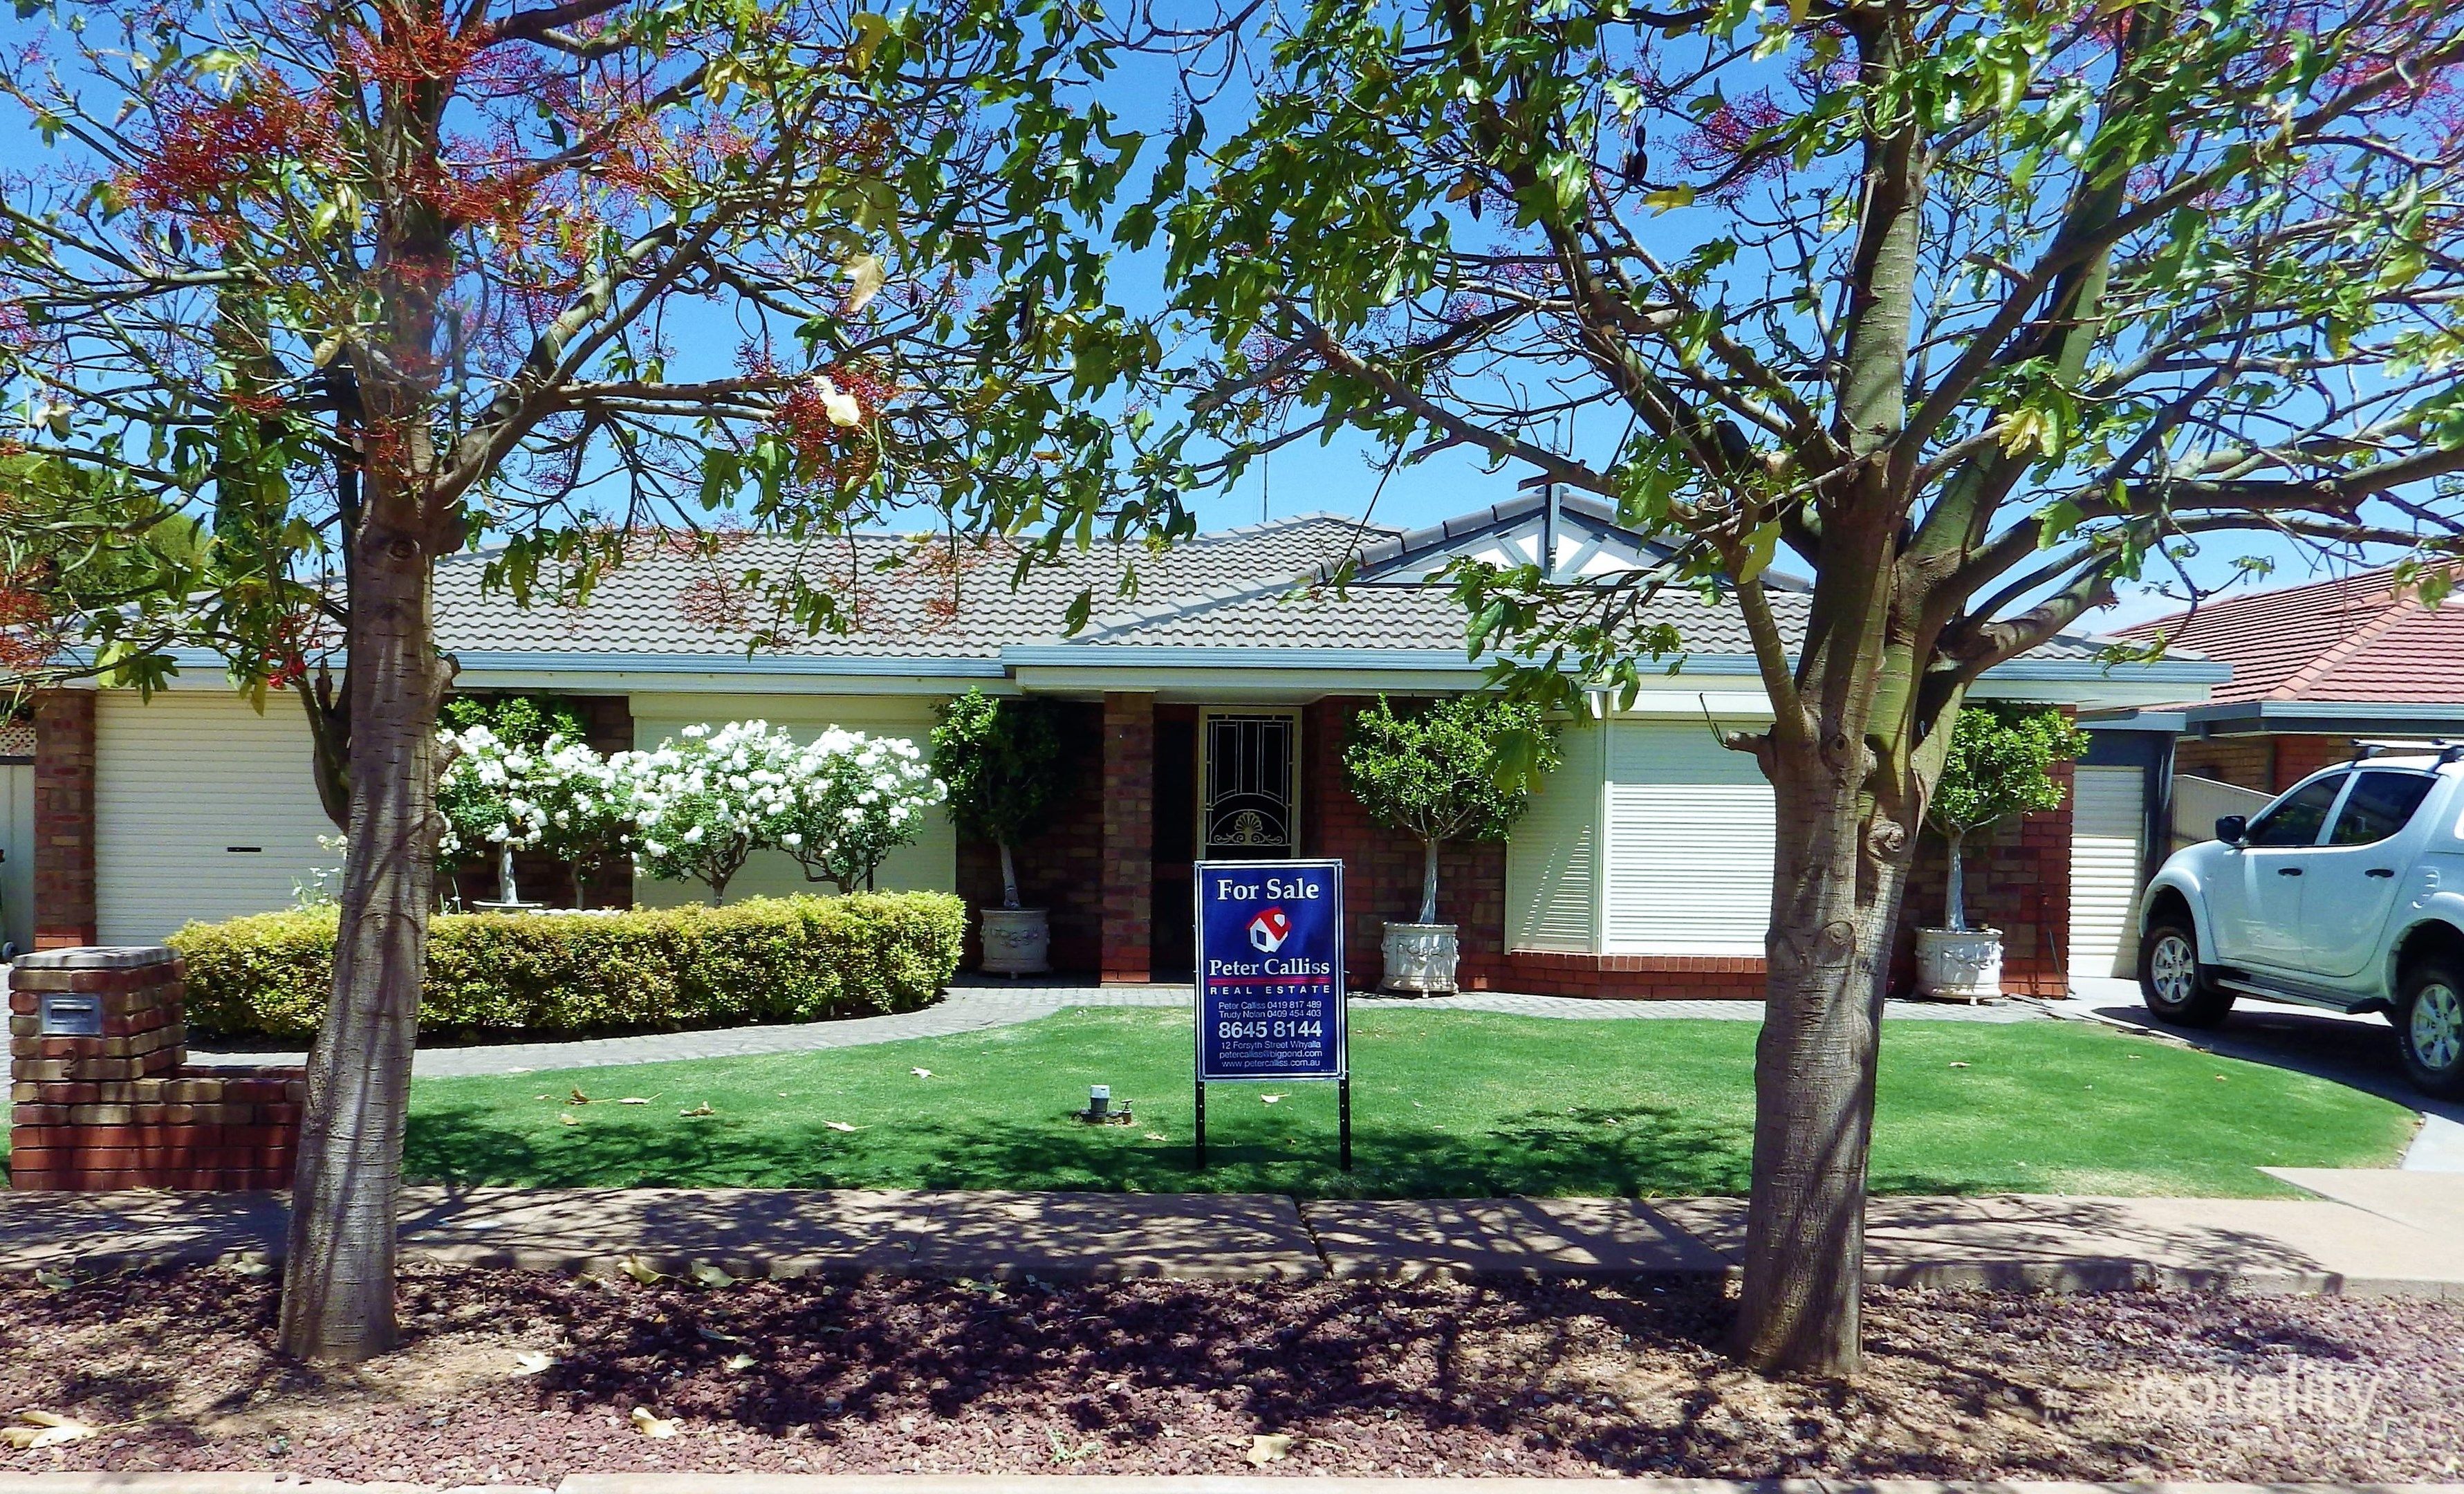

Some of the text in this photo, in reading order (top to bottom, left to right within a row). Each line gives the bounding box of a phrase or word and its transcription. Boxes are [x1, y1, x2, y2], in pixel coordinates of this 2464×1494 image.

[1217, 877, 1319, 900] For Sale
[1209, 958, 1331, 976] Peter Calliss
[1210, 985, 1331, 995] REAL ESTATE
[1306, 1000, 1322, 1008] 489
[1219, 1011, 1241, 1020] Trudy
[1219, 1020, 1323, 1038] 8645 8144
[1233, 1041, 1262, 1050] Forsyth
[1264, 1040, 1288, 1049] Street
[1290, 1040, 1322, 1050] Whyalla
[1222, 1059, 1320, 1067] www.petercalliss.com.au
